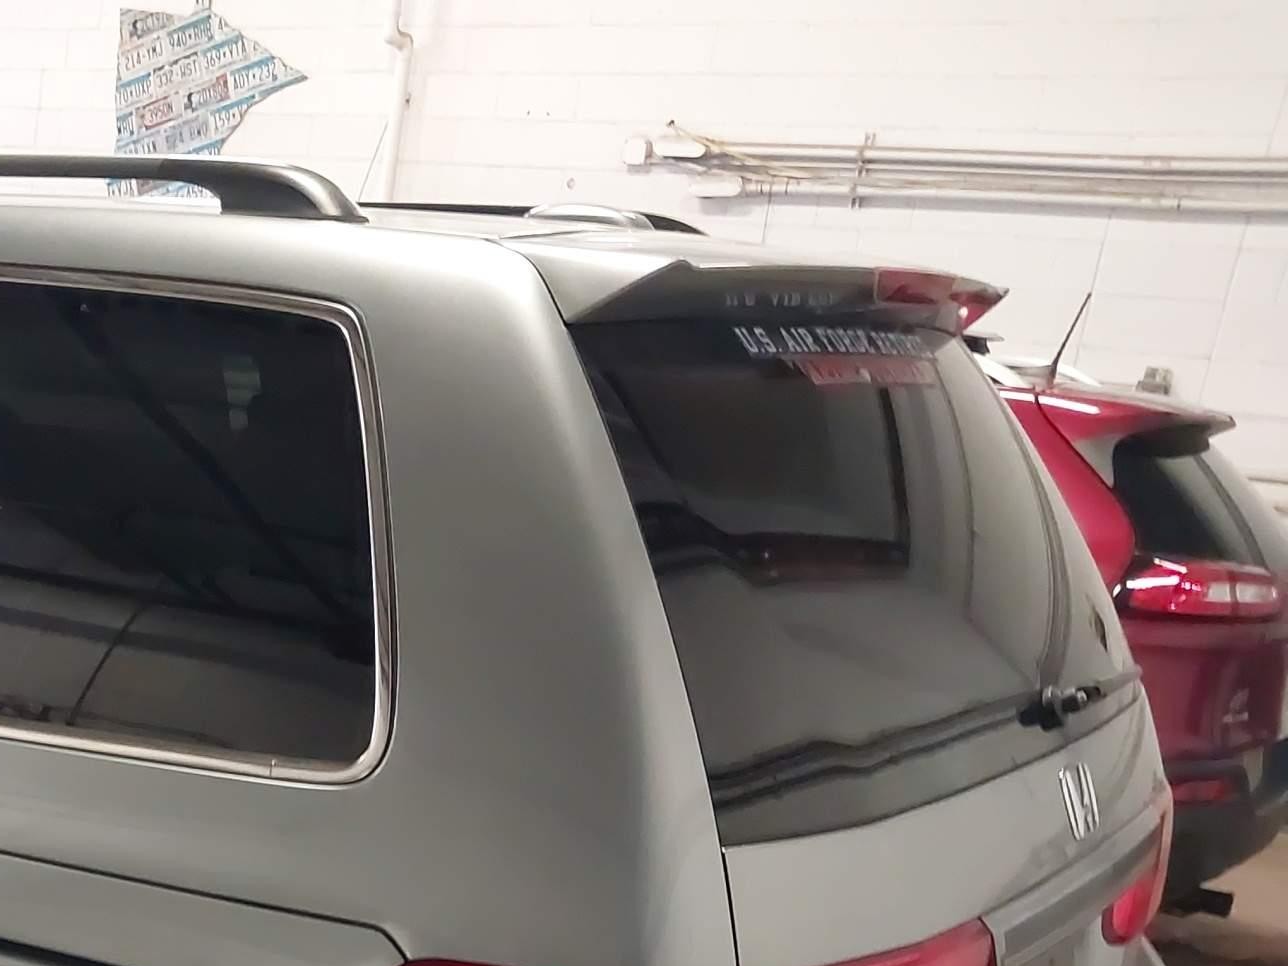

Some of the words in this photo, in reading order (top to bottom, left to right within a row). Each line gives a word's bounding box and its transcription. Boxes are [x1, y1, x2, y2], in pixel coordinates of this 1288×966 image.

[733, 326, 783, 353] U.S.
[778, 326, 822, 353] AIR
[815, 327, 877, 354] FORCE
